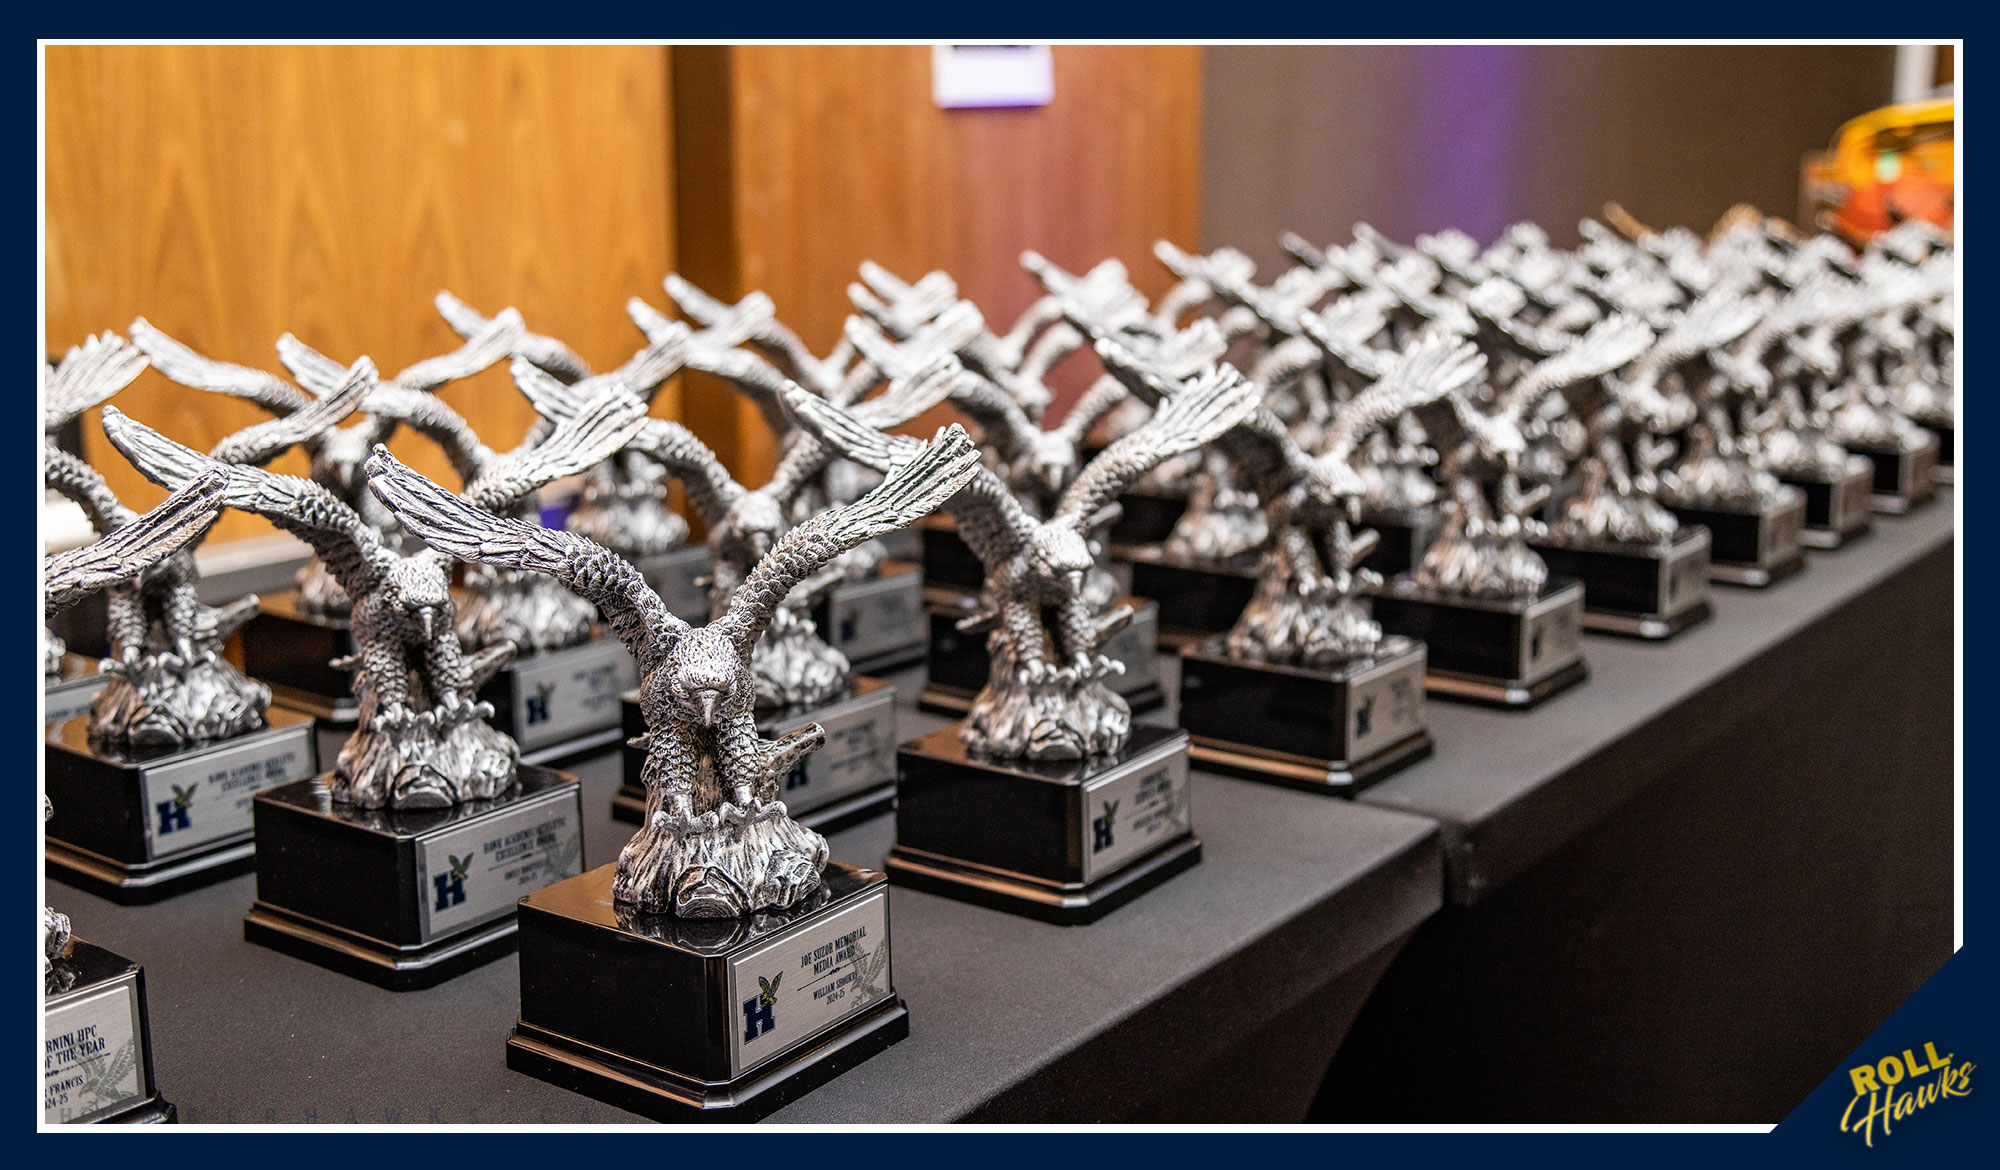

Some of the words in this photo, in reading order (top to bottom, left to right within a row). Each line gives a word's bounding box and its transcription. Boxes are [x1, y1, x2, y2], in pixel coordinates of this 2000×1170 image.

[157, 799, 191, 836] H
[433, 871, 467, 913] H
[800, 952, 812, 968] JOE
[813, 942, 834, 961] SUZOR
[834, 926, 867, 950] MEMORIAL
[813, 956, 834, 976] MEDIA
[835, 945, 856, 964] AWARD
[813, 981, 835, 1000] WILLIAM
[77, 1024, 97, 1042] HPC
[743, 993, 776, 1046] H
[56, 1047, 76, 1065] THE
[79, 1037, 106, 1056] YEAR
[49, 1075, 84, 1096] FRANCIS
